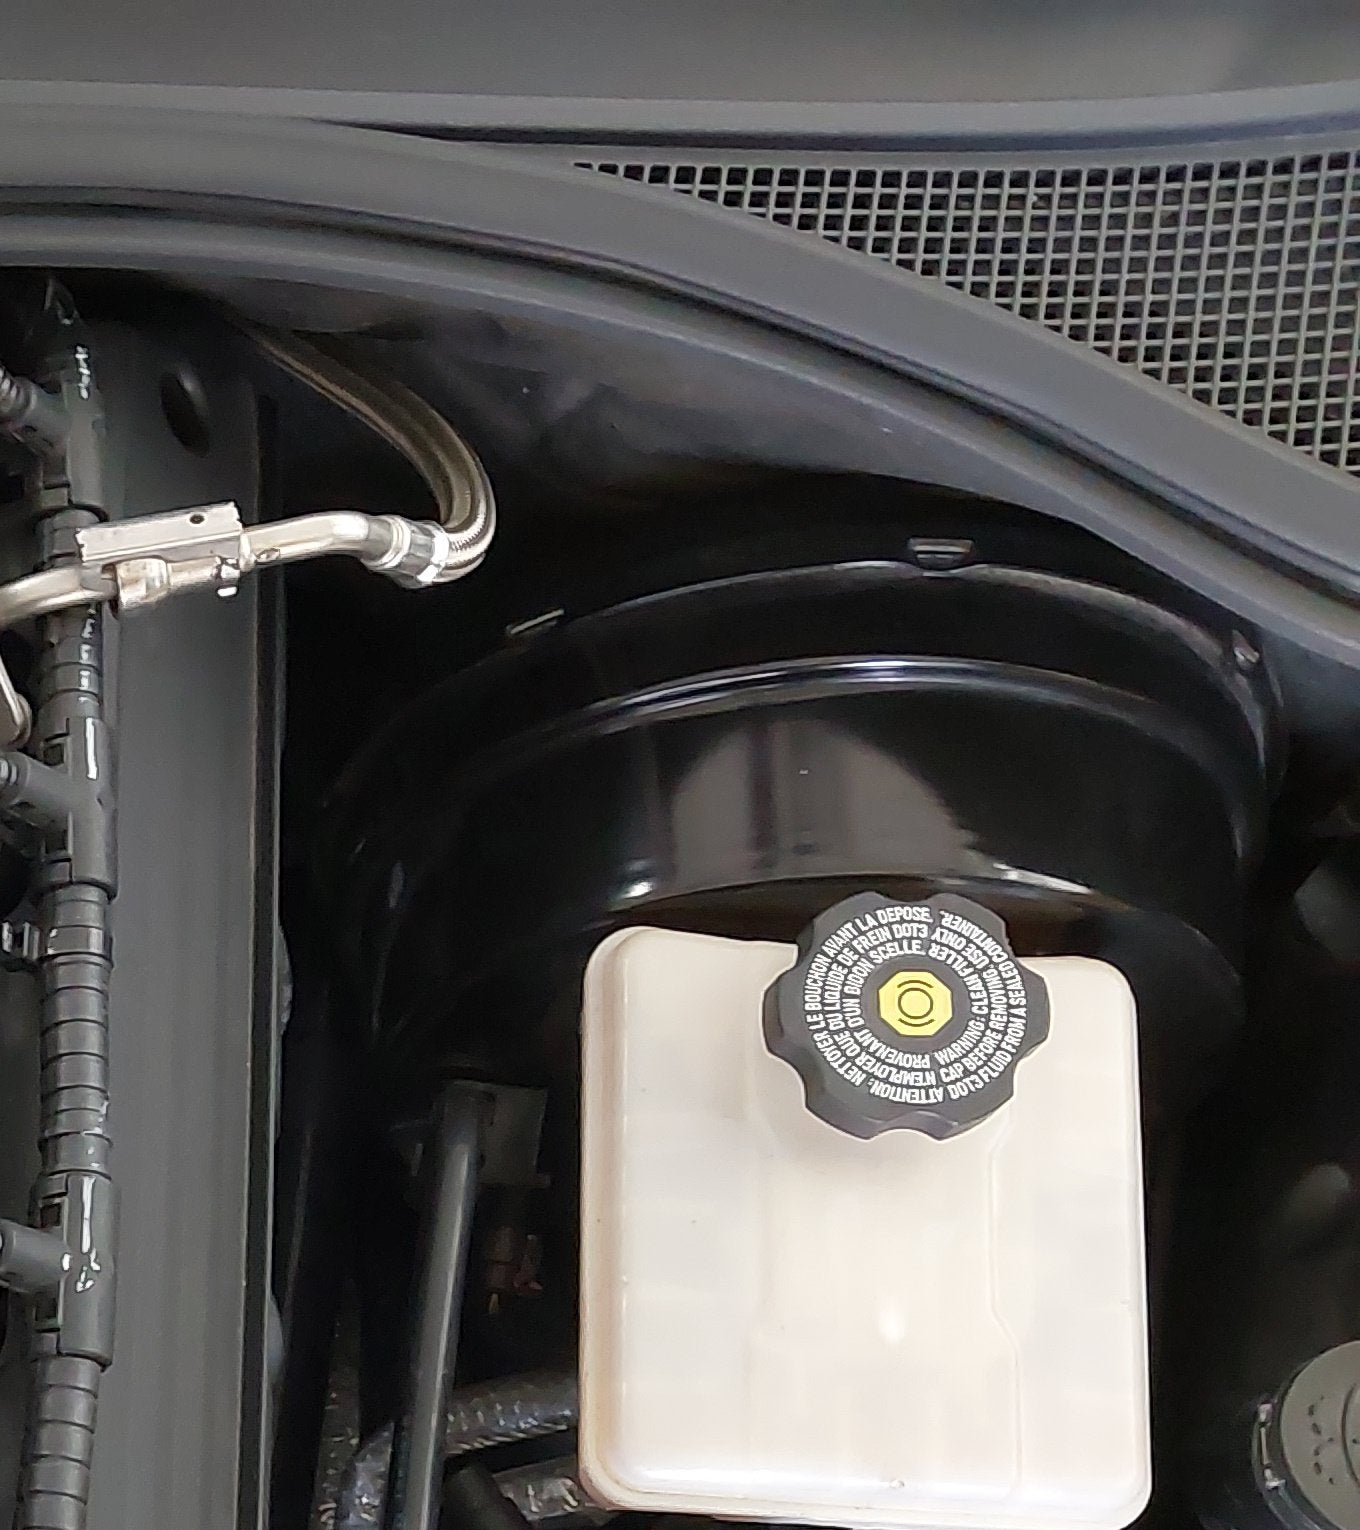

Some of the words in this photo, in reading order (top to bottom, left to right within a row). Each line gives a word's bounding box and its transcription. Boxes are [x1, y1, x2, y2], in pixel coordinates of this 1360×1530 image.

[855, 914, 878, 931] LA
[892, 923, 928, 938] DOT3
[822, 922, 858, 957] AVANT
[852, 926, 891, 953] FREIN
[931, 927, 966, 950] ONLY
[838, 948, 854, 966] DE
[928, 943, 974, 976] FILLER
[961, 943, 989, 969] USE
[805, 954, 832, 1010] BOUCHON
[824, 964, 848, 1010] LIQUIDE
[844, 958, 875, 995] BIDON
[999, 961, 1026, 1005] SEALED
[963, 974, 988, 1014] CLEAN
[806, 1014, 825, 1029] LE
[826, 1013, 845, 1030] DU
[1009, 1008, 1027, 1017] A
[833, 1031, 860, 1056] QUE
[854, 1029, 930, 1068] PROVENANT
[1000, 1017, 1026, 1052] FROM
[813, 1031, 866, 1086] NETTOYER
[961, 1029, 1002, 1071] BEFORE
[940, 1063, 964, 1082] CAP
[978, 1051, 1012, 1082] FLUID
[946, 1075, 984, 1099] DOT3
